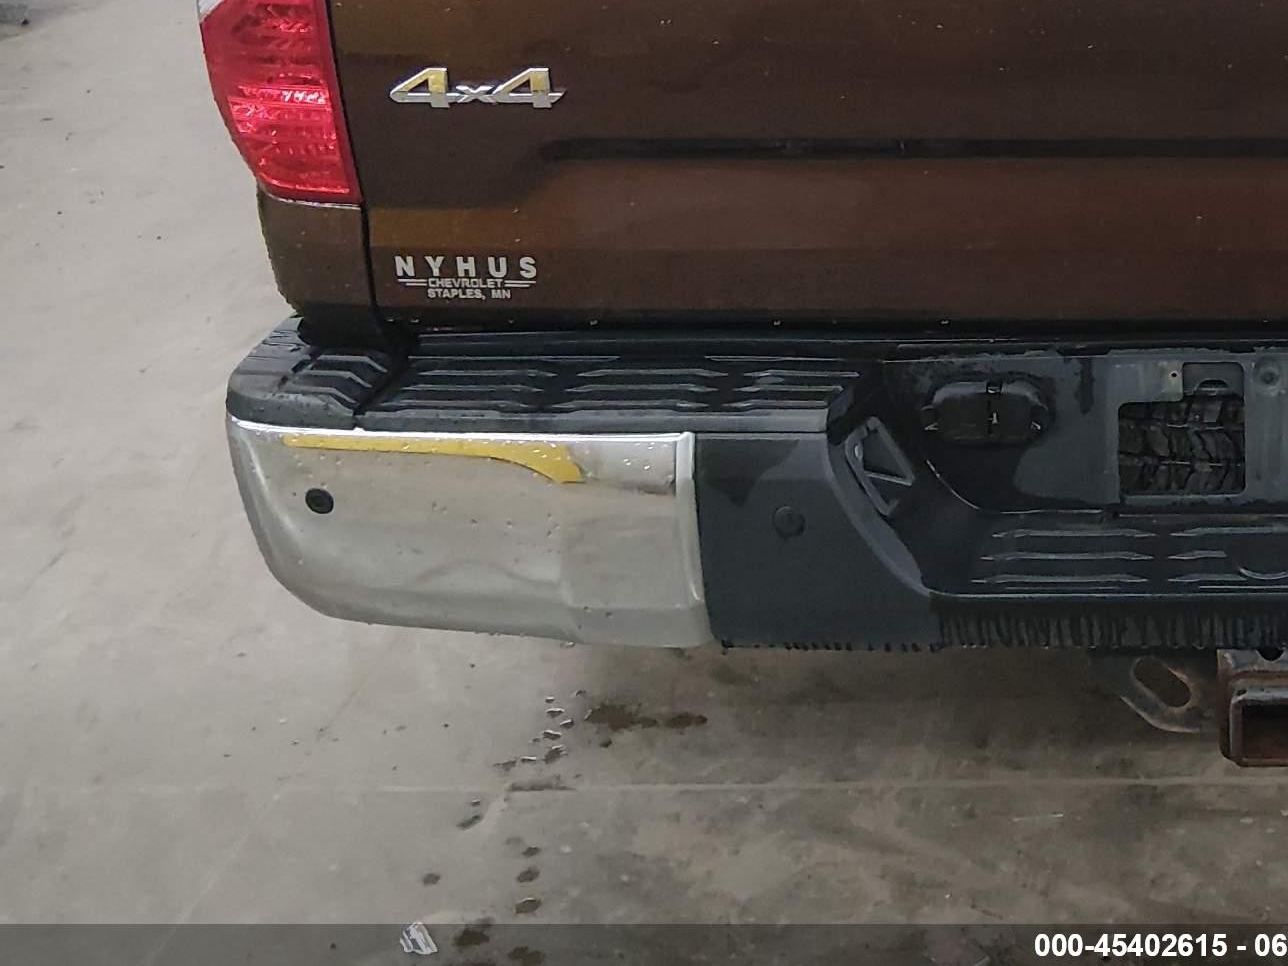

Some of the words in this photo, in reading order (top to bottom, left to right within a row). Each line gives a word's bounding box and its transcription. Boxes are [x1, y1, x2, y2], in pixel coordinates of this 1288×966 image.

[394, 255, 537, 279] NYHUS
[428, 278, 503, 288] CHEVROLET
[427, 288, 486, 300] STAPLES,
[491, 289, 511, 299] MN
